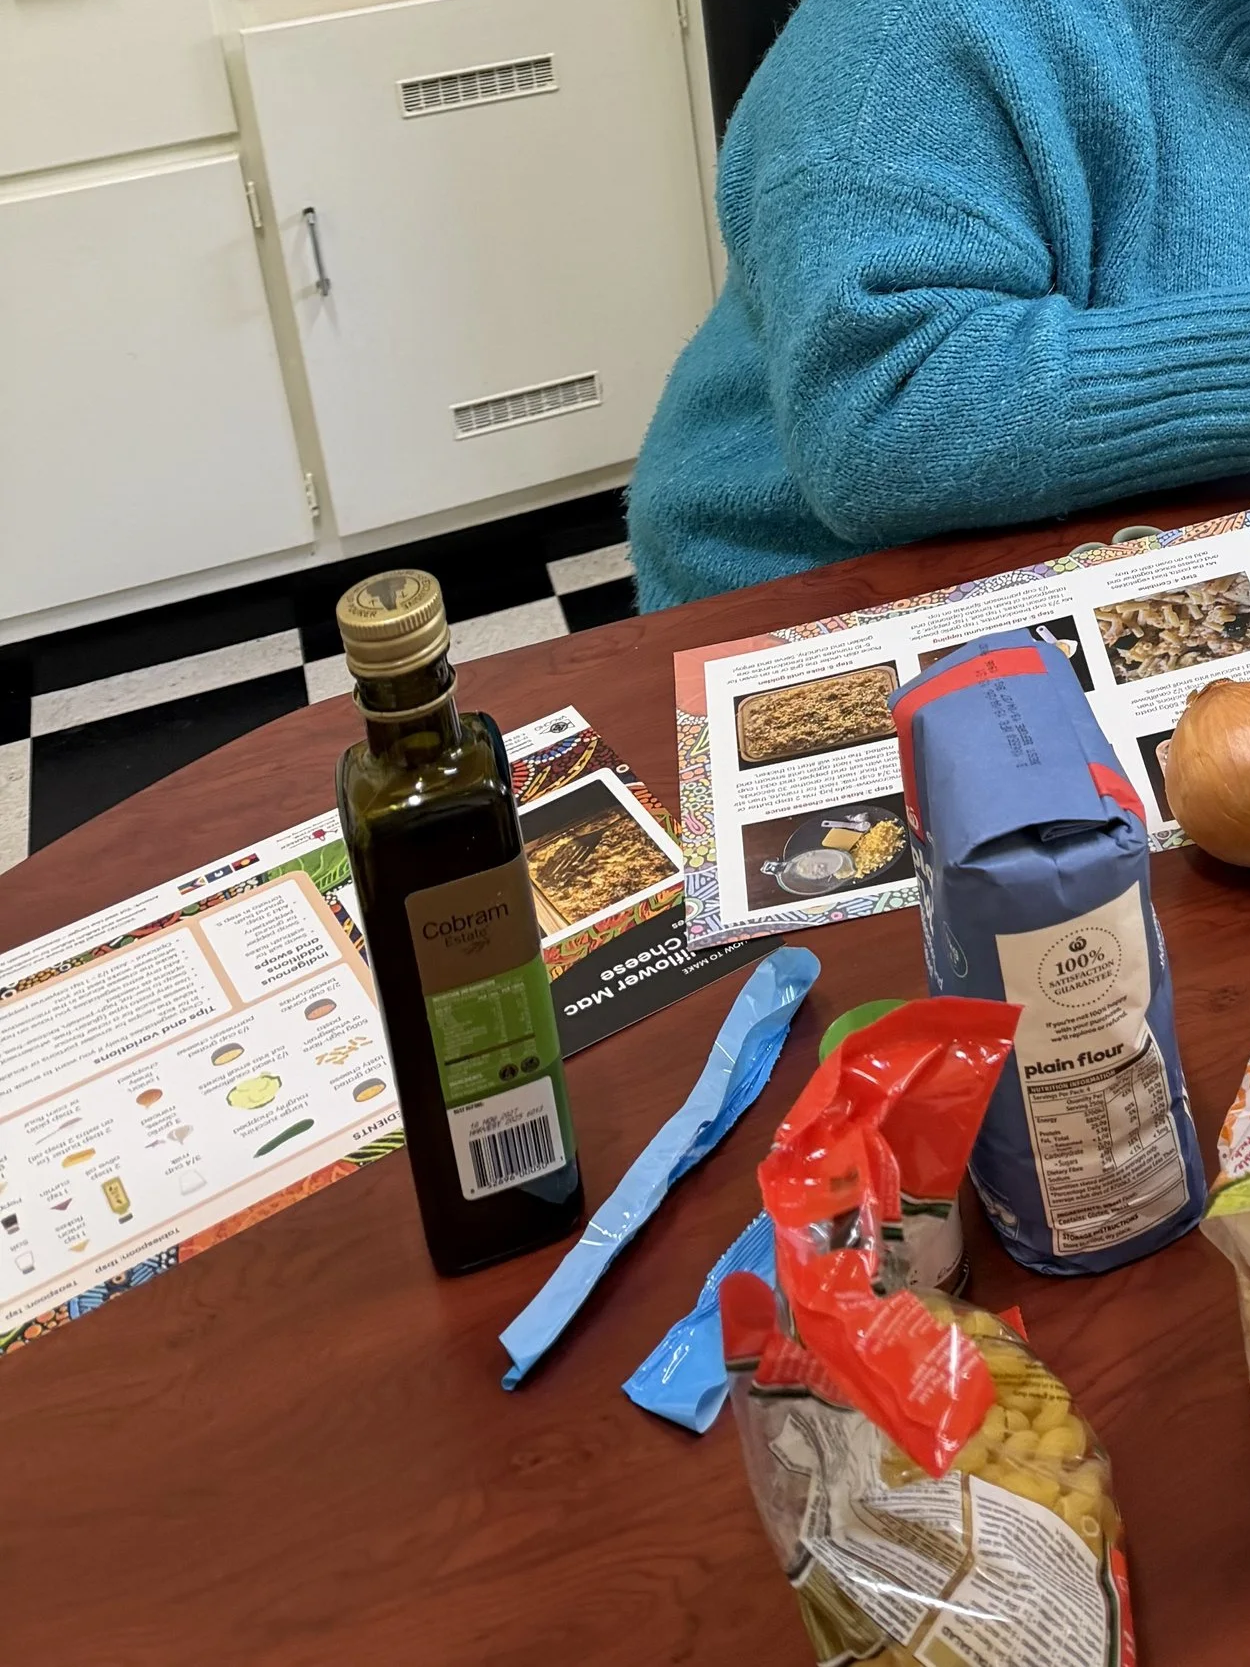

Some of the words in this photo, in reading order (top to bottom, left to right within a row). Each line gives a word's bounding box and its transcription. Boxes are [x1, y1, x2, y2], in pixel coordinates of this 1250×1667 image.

[1179, 572, 1197, 582] Step
[1136, 579, 1172, 592] Combine
[1012, 615, 1028, 624] Add
[1036, 608, 1054, 618] Step
[962, 619, 1011, 636] breadcrumb
[931, 631, 962, 644] topping
[756, 659, 772, 668] and
[773, 653, 795, 664] Serve
[835, 658, 853, 668] Step
[786, 670, 804, 680] until
[805, 665, 825, 675] Bake
[757, 674, 785, 687] golden
[1171, 678, 1193, 688] small
[1133, 705, 1158, 716] pasta
[1159, 700, 1179, 711] 500g
[839, 789, 863, 800] Make
[873, 782, 894, 793] Step
[791, 798, 823, 810] cheese
[824, 794, 838, 804] the
[764, 804, 791, 816] sauce
[422, 901, 510, 942] Cobram
[293, 935, 319, 953] and
[444, 927, 488, 949] Estate
[253, 947, 293, 972] swaps
[265, 942, 324, 975] additions
[600, 937, 682, 982] Cheese
[707, 949, 723, 961] TO
[1054, 946, 1105, 977] 100%
[260, 949, 329, 987] Indigenous
[680, 956, 709, 975] MAKE
[1048, 958, 1115, 988] SATISFACTION
[325, 980, 340, 993] 2/3
[1054, 969, 1113, 997] GUARANTEE
[278, 975, 336, 1008] breadcrumbs
[307, 987, 325, 1001] cup
[279, 995, 307, 1014] panko
[563, 989, 615, 1017] Mac
[1076, 1013, 1089, 1022] not
[1106, 995, 1128, 1010] happy
[188, 1002, 216, 1022] Tips
[160, 1016, 187, 1035] and
[209, 1014, 255, 1041] parmesan
[237, 1024, 249, 1035] 1/3
[1054, 1026, 1072, 1035] with
[1072, 1022, 1090, 1034] your
[217, 1029, 236, 1044] cup
[1069, 1027, 1097, 1042] replace
[92, 1029, 159, 1067] variations
[174, 1036, 208, 1057] cheese
[187, 1038, 218, 1059] grated
[270, 1044, 285, 1056] cut
[251, 1051, 269, 1066] into
[275, 1049, 288, 1061] 1/2
[361, 1052, 384, 1069] tasty
[1024, 1057, 1075, 1079] plain
[1077, 1042, 1125, 1068] flour
[226, 1060, 251, 1078] small
[251, 1056, 275, 1073] head
[363, 1060, 381, 1075] cup
[197, 1072, 226, 1092] florets
[328, 1065, 360, 1086] cheese
[332, 1070, 363, 1092] grated
[1029, 1082, 1069, 1094] NUTRITION
[1069, 1069, 1116, 1089] INFORMATION
[274, 1090, 309, 1114] roughly
[1032, 1092, 1058, 1101] Servings
[1058, 1090, 1070, 1098] Per
[279, 1100, 303, 1118] large
[231, 1108, 274, 1135] chopped
[351, 1109, 401, 1142] EDIENTS
[170, 1150, 190, 1166] milk
[184, 1152, 201, 1167] 3/4
[1044, 1148, 1084, 1160] Carbohydrate
[163, 1160, 183, 1177] cup
[1046, 1169, 1068, 1178] Dietary
[94, 1257, 118, 1276] tbsp
[4, 1306, 22, 1322] tsp
